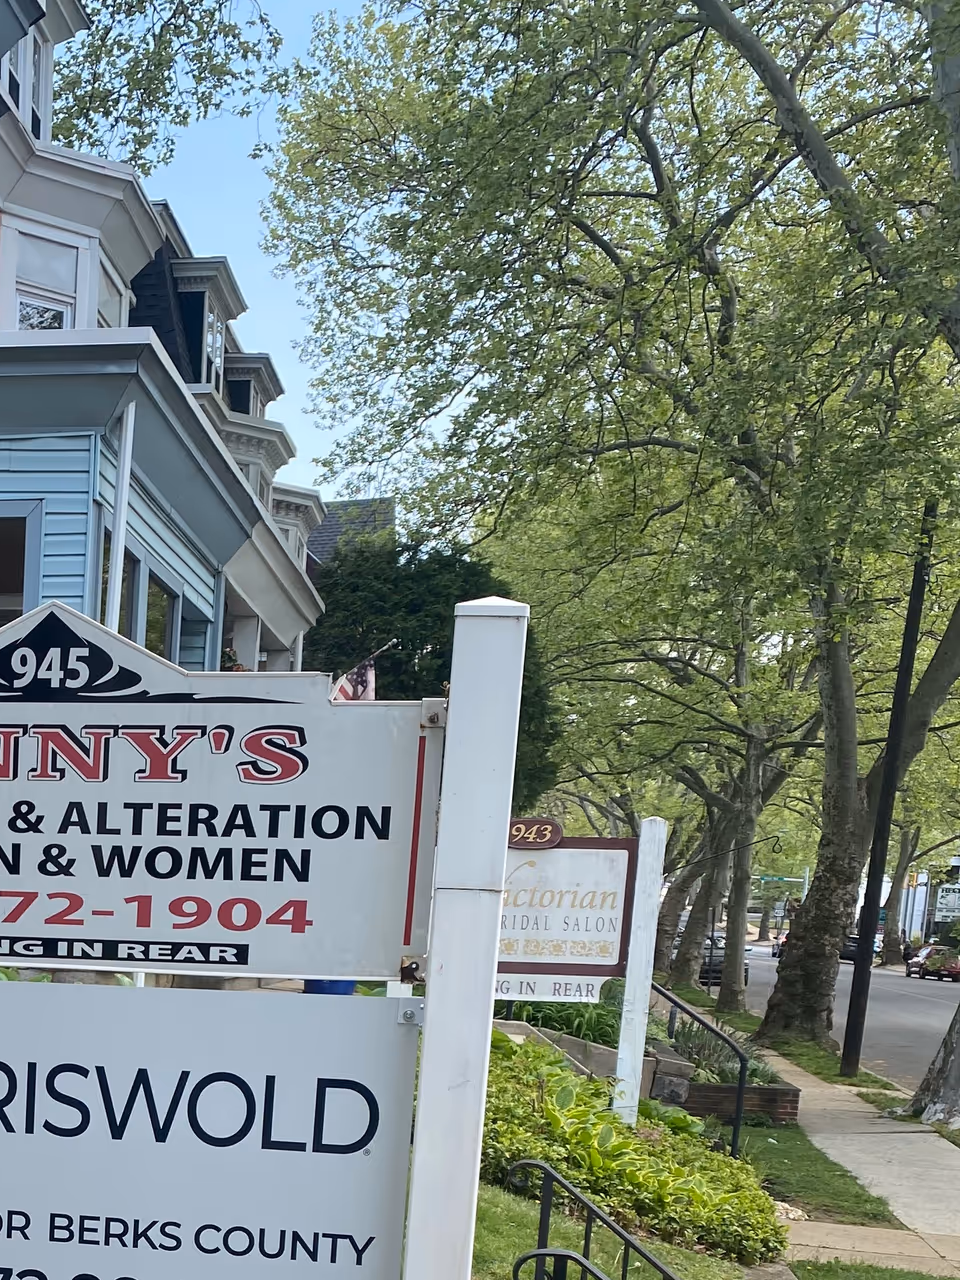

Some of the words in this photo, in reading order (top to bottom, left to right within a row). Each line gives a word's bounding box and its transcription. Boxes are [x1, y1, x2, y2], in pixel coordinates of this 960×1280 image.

[10, 646, 90, 689] 945
[7, 800, 45, 834] &
[56, 801, 392, 841] ALTERATION
[510, 824, 552, 843] 943
[37, 843, 77, 877] &
[90, 844, 312, 883] WOMEN
[504, 862, 618, 910] ictorian
[500, 915, 551, 931] RIDAL
[563, 916, 619, 933] SALON
[57, 941, 103, 958] IN
[117, 943, 239, 963] REAR
[518, 981, 537, 995] IN
[552, 982, 595, 998] REAR
[47, 1212, 183, 1252] BERKS
[192, 1223, 377, 1266] COUNTY
